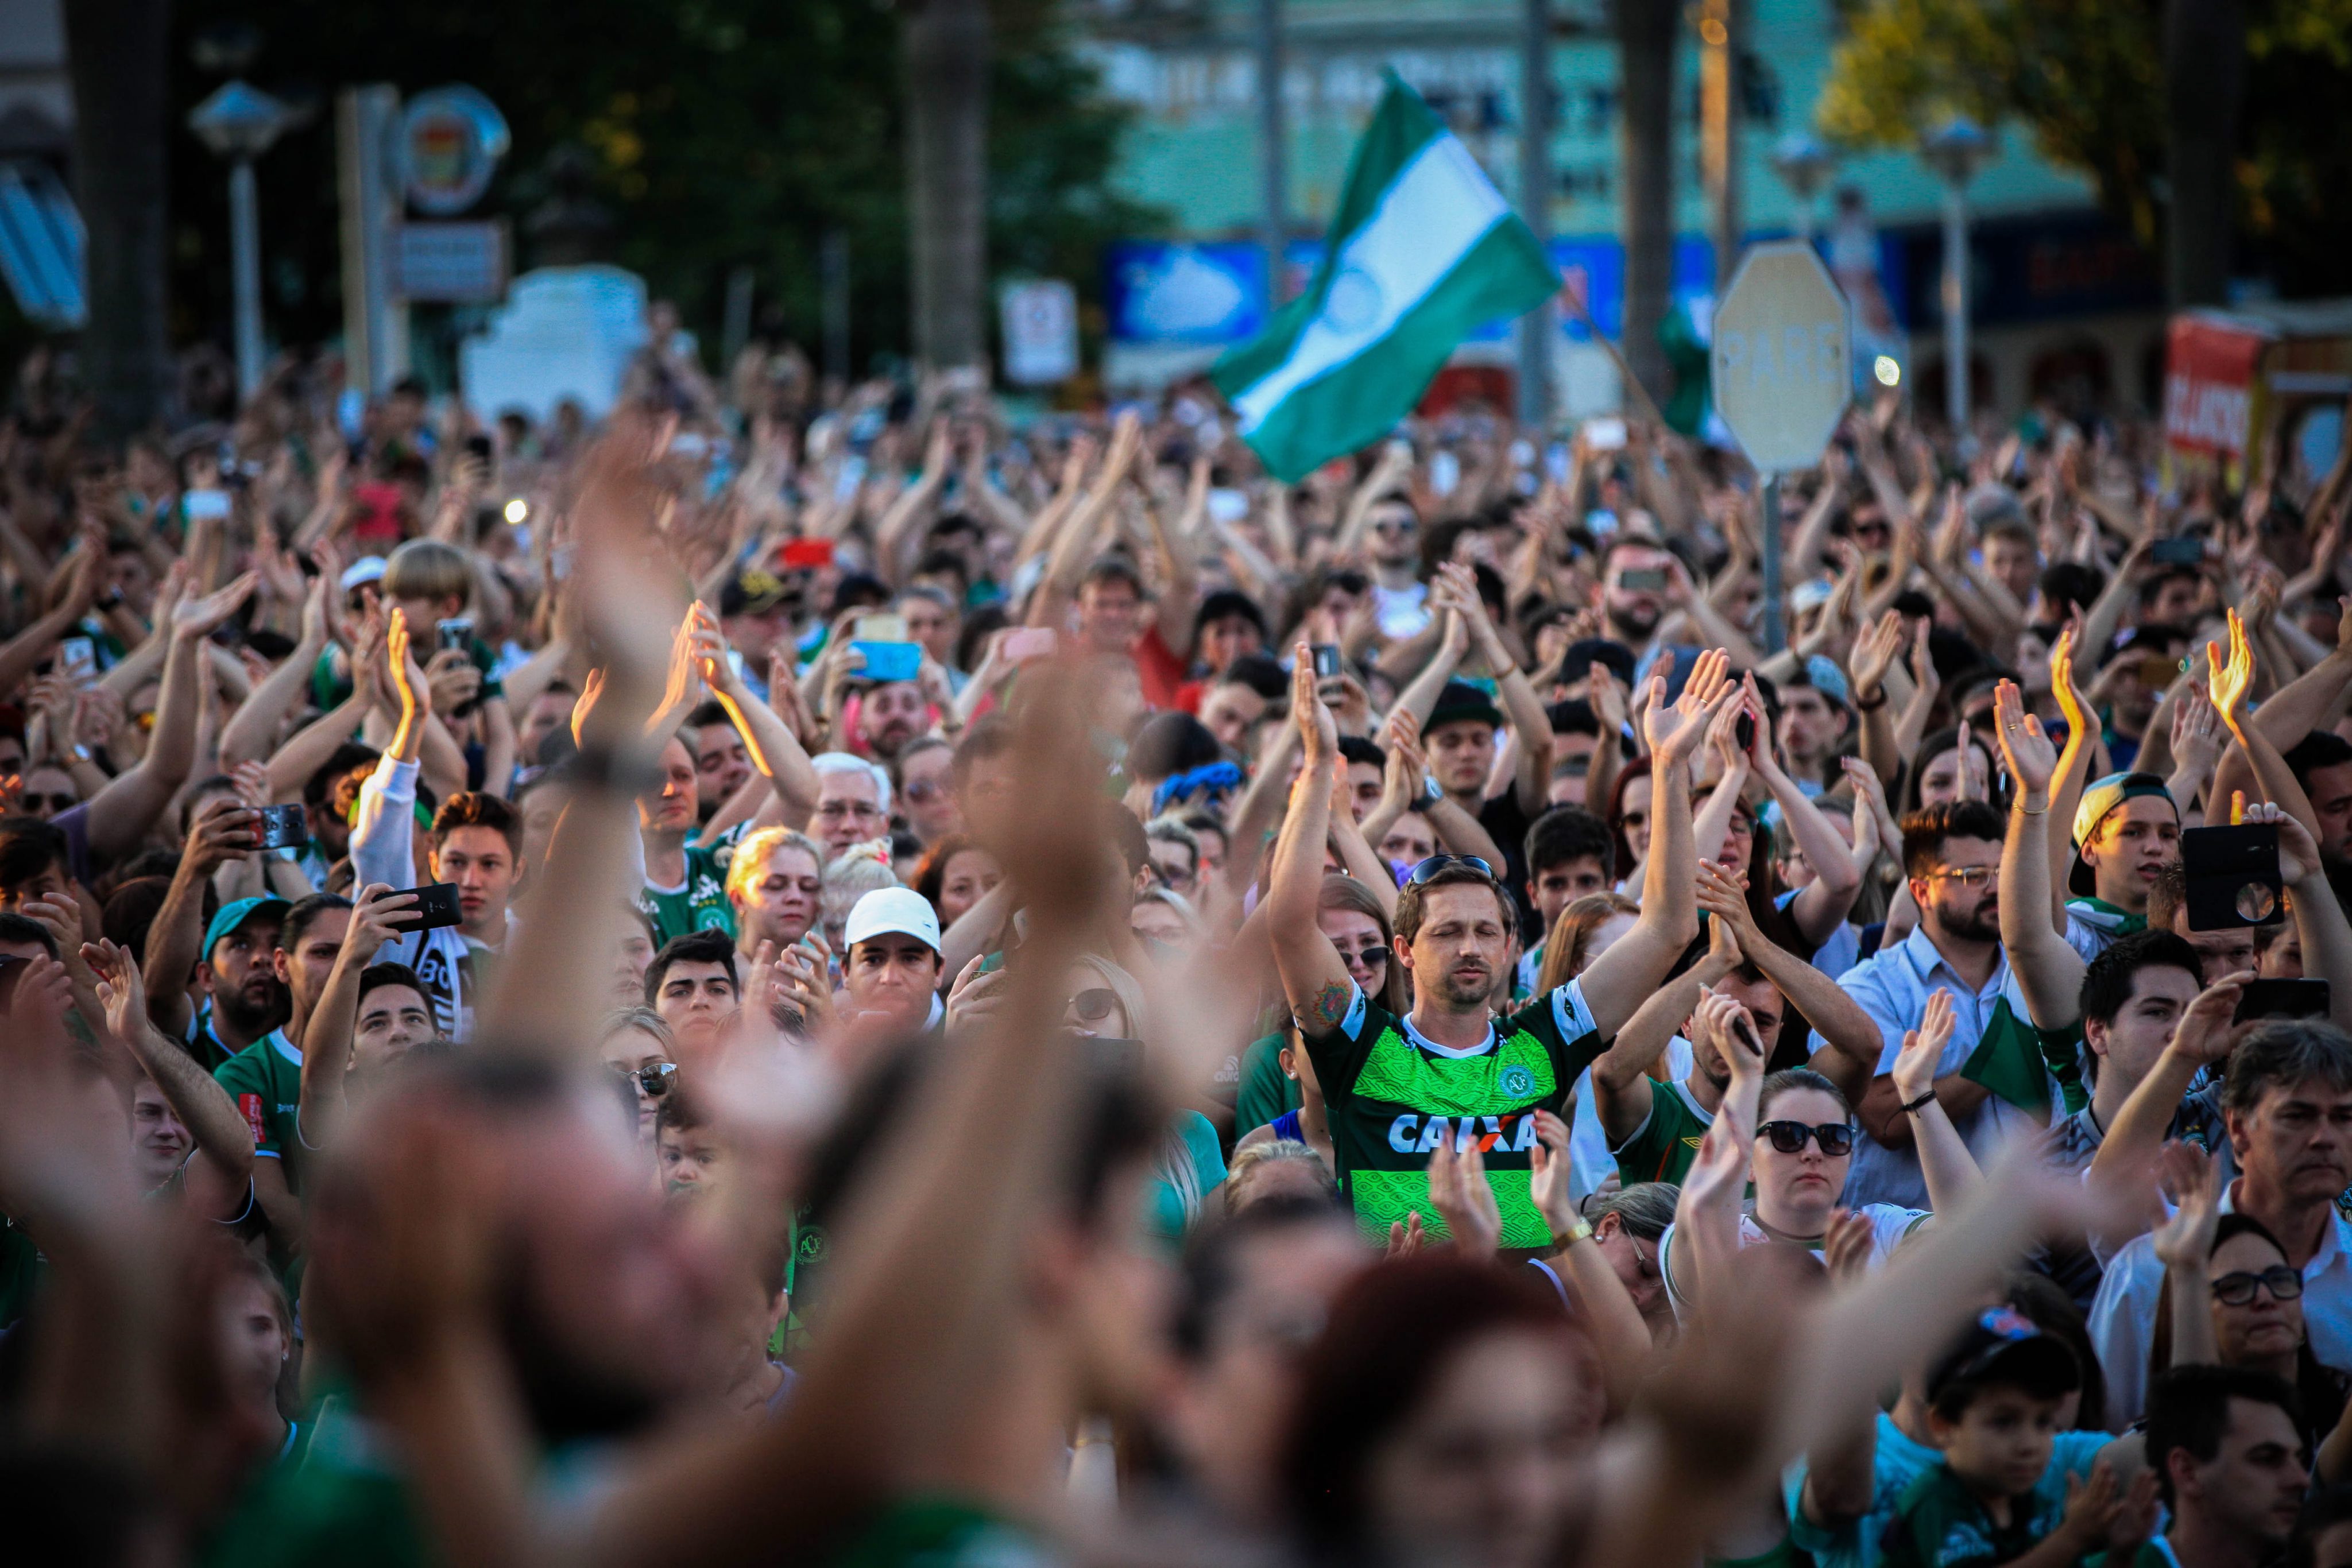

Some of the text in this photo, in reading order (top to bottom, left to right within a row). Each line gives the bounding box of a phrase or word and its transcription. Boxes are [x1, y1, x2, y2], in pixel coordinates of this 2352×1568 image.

[1723, 321, 1837, 388] PARE
[1388, 1114, 1539, 1153] CAIXA
[801, 1234, 822, 1254] ACF
